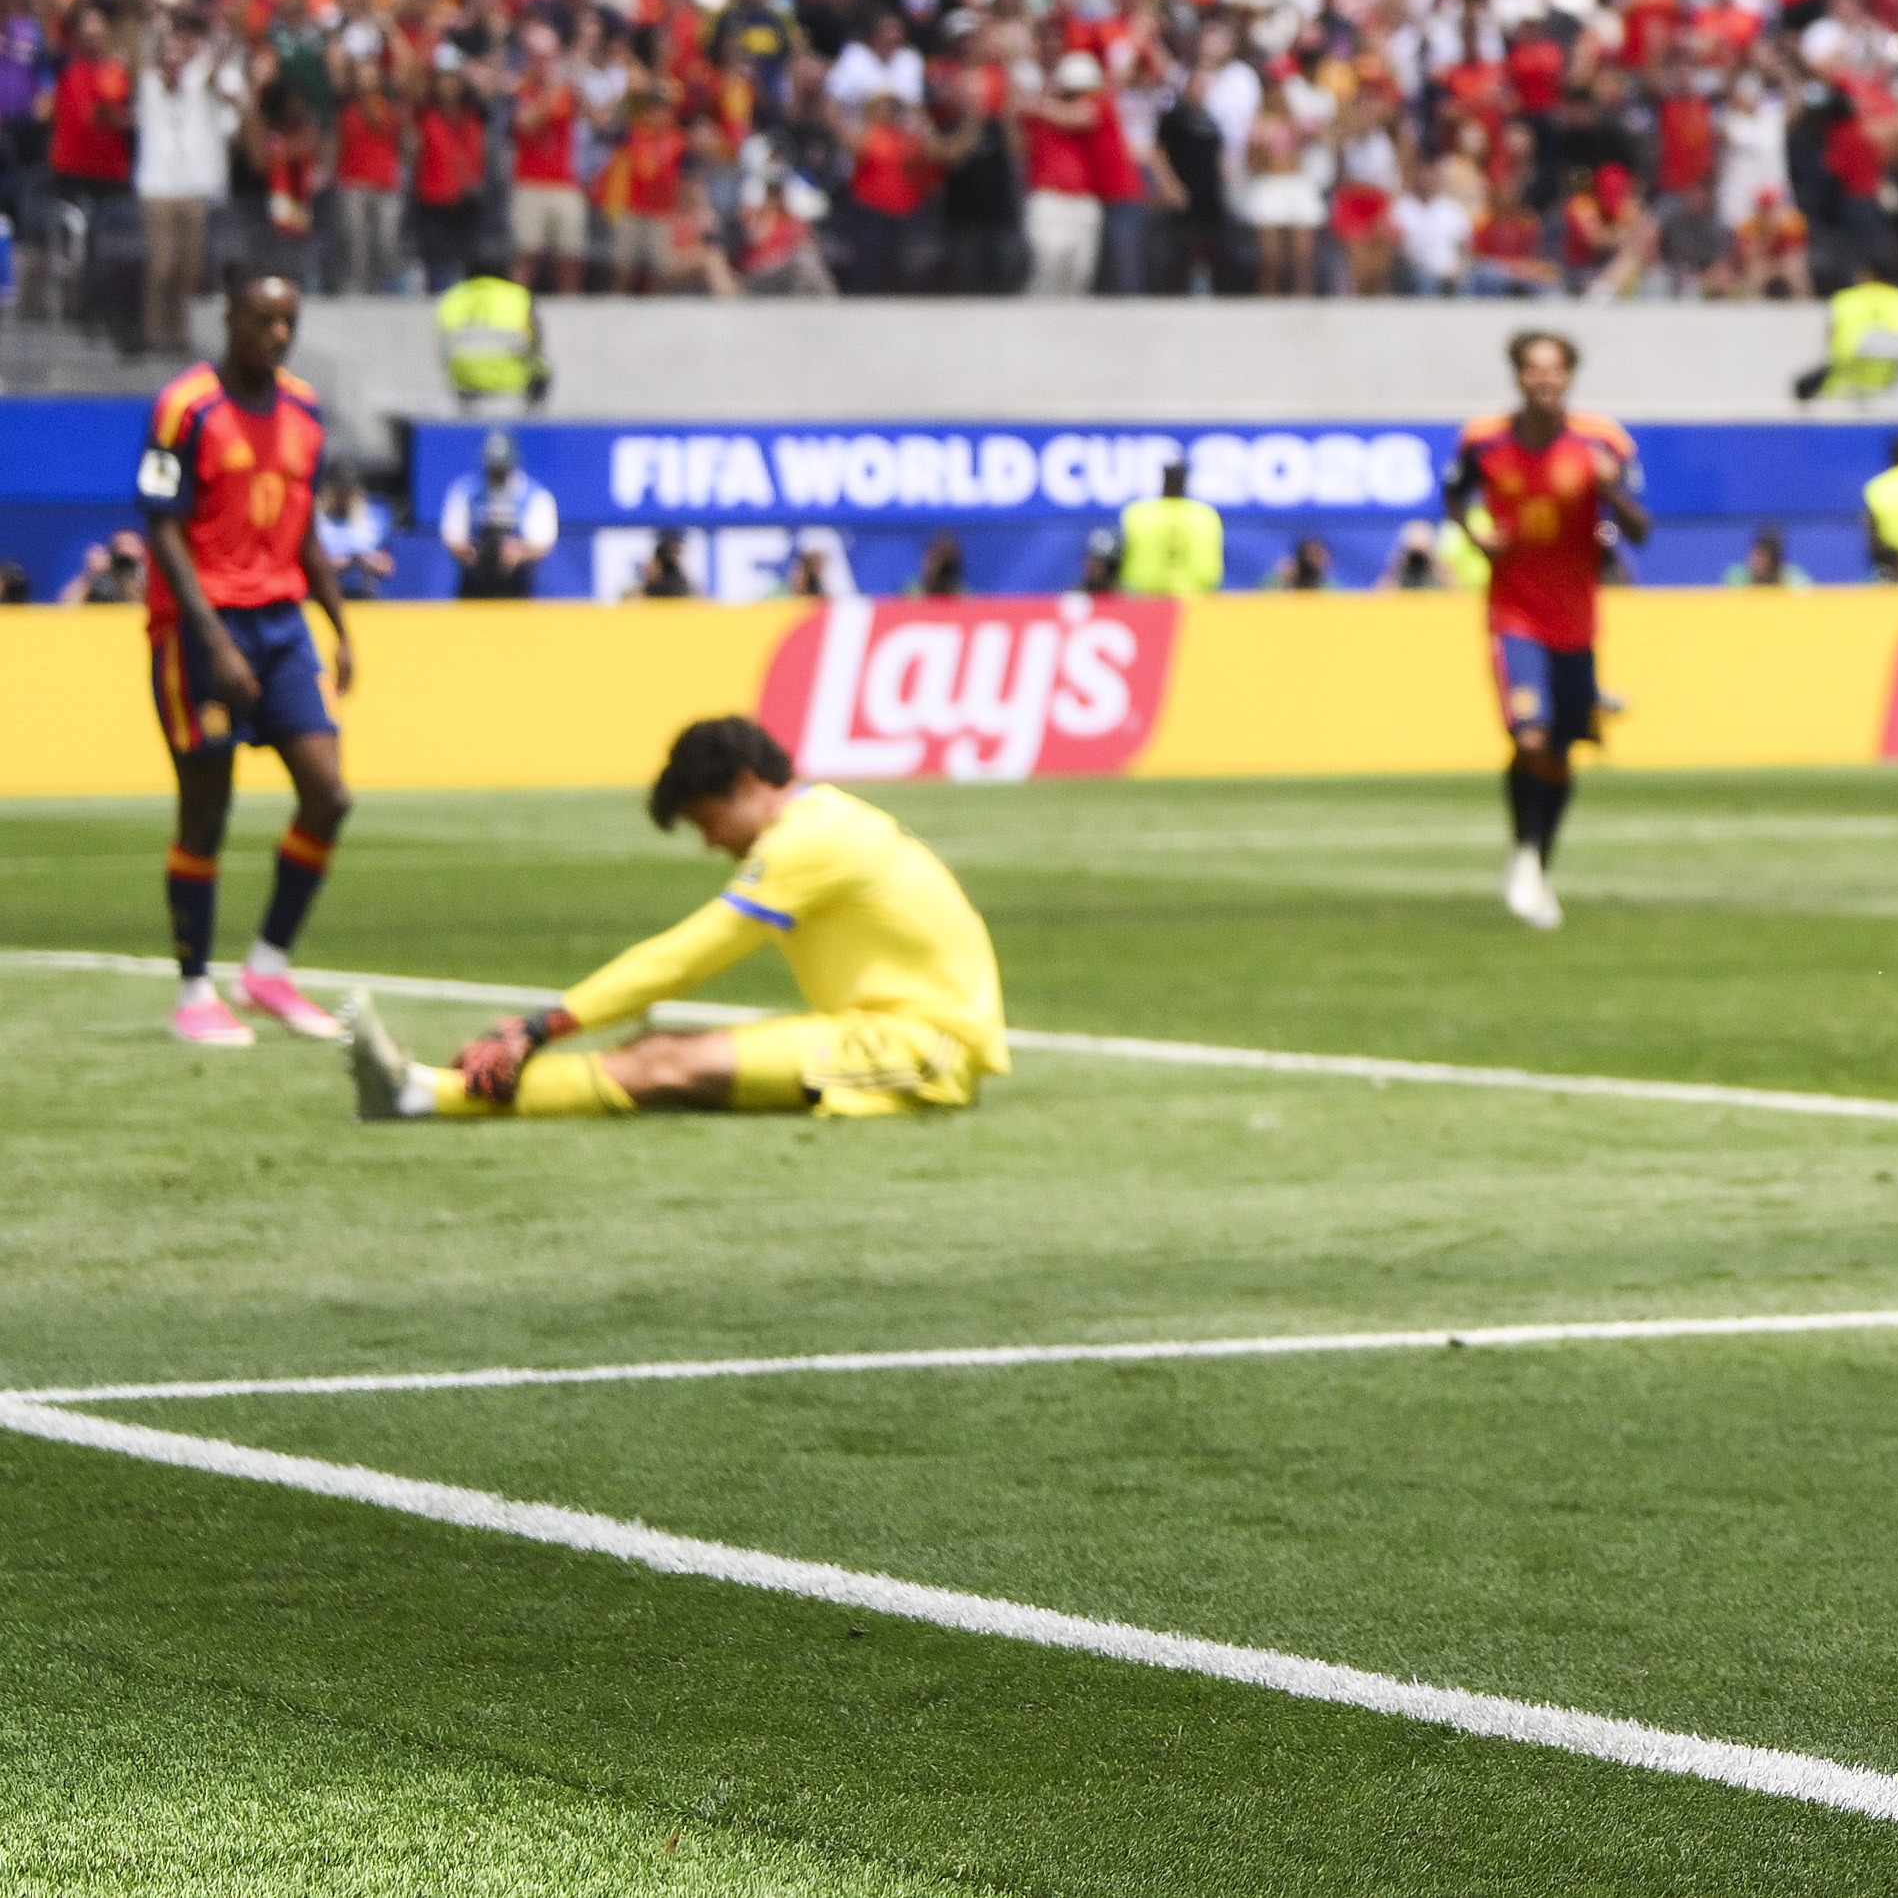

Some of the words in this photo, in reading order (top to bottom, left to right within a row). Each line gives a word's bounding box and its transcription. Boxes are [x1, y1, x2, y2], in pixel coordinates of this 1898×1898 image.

[610, 434, 775, 510] FIFA
[771, 433, 1040, 510] WORLD
[1040, 433, 1187, 509] CUP
[1187, 433, 1436, 509] 2026
[593, 524, 862, 605] FIFA
[796, 592, 1137, 783] Lay's
